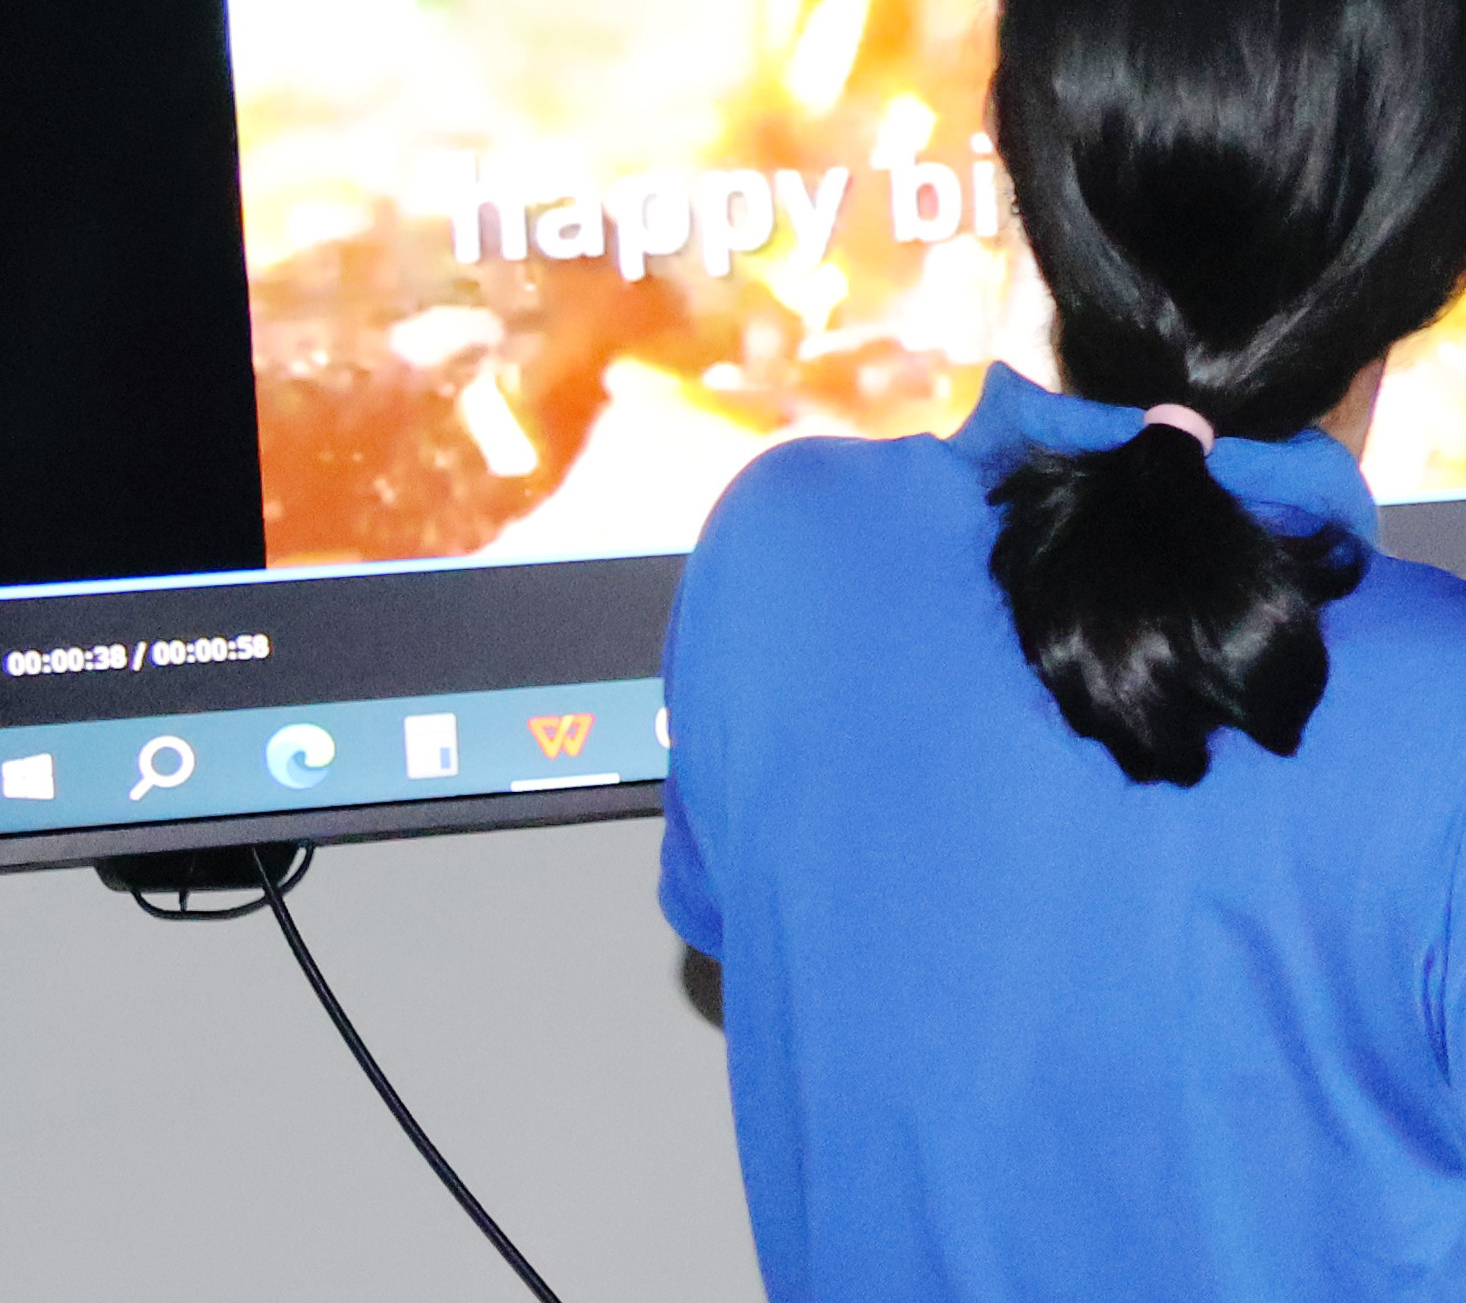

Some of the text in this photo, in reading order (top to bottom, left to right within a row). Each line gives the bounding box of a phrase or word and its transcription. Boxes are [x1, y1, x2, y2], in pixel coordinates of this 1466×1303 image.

[450, 144, 850, 285] happy
[4, 643, 128, 676] 00:00:38
[151, 633, 270, 667] 00:00:58
